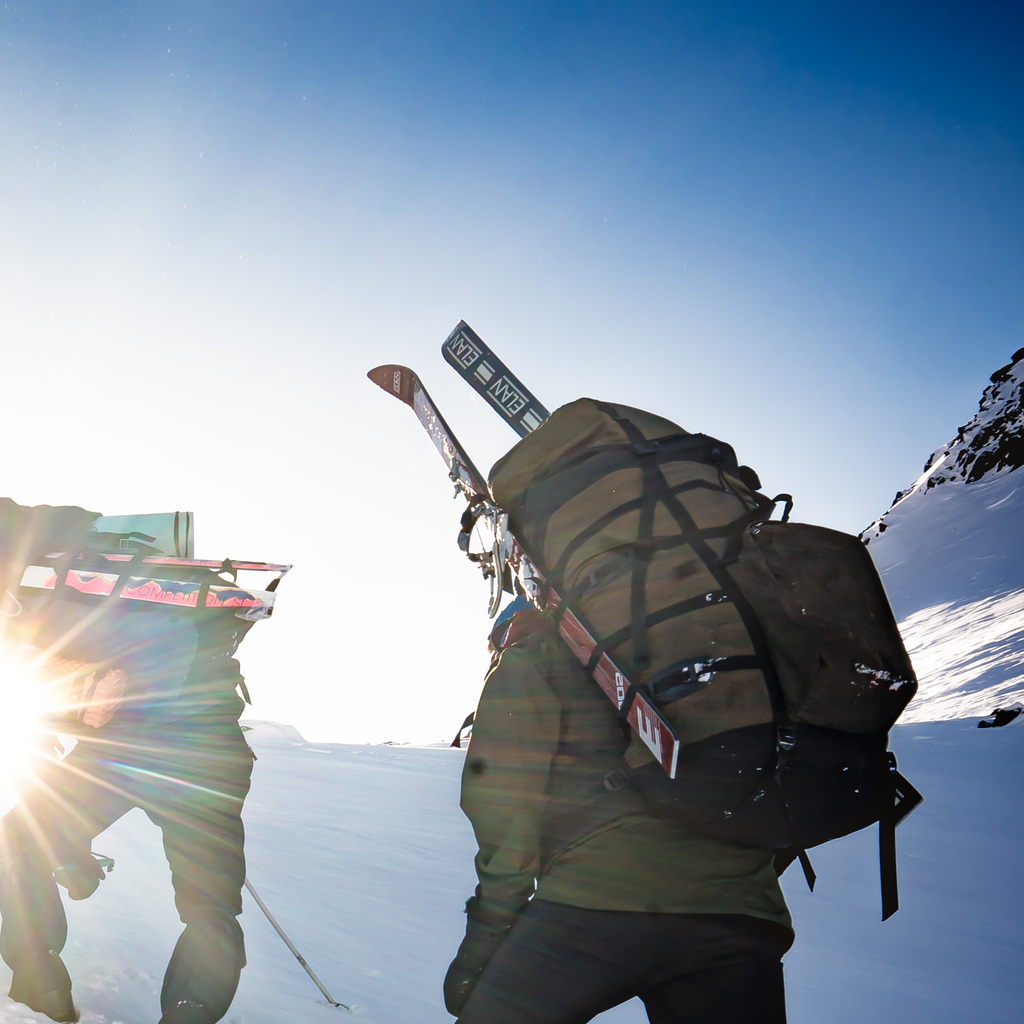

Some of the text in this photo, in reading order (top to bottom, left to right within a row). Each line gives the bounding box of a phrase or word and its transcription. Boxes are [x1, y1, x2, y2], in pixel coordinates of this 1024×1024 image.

[449, 333, 480, 367] ELAN
[489, 378, 526, 415] ELAN
[126, 585, 226, 607] COMPETITON
